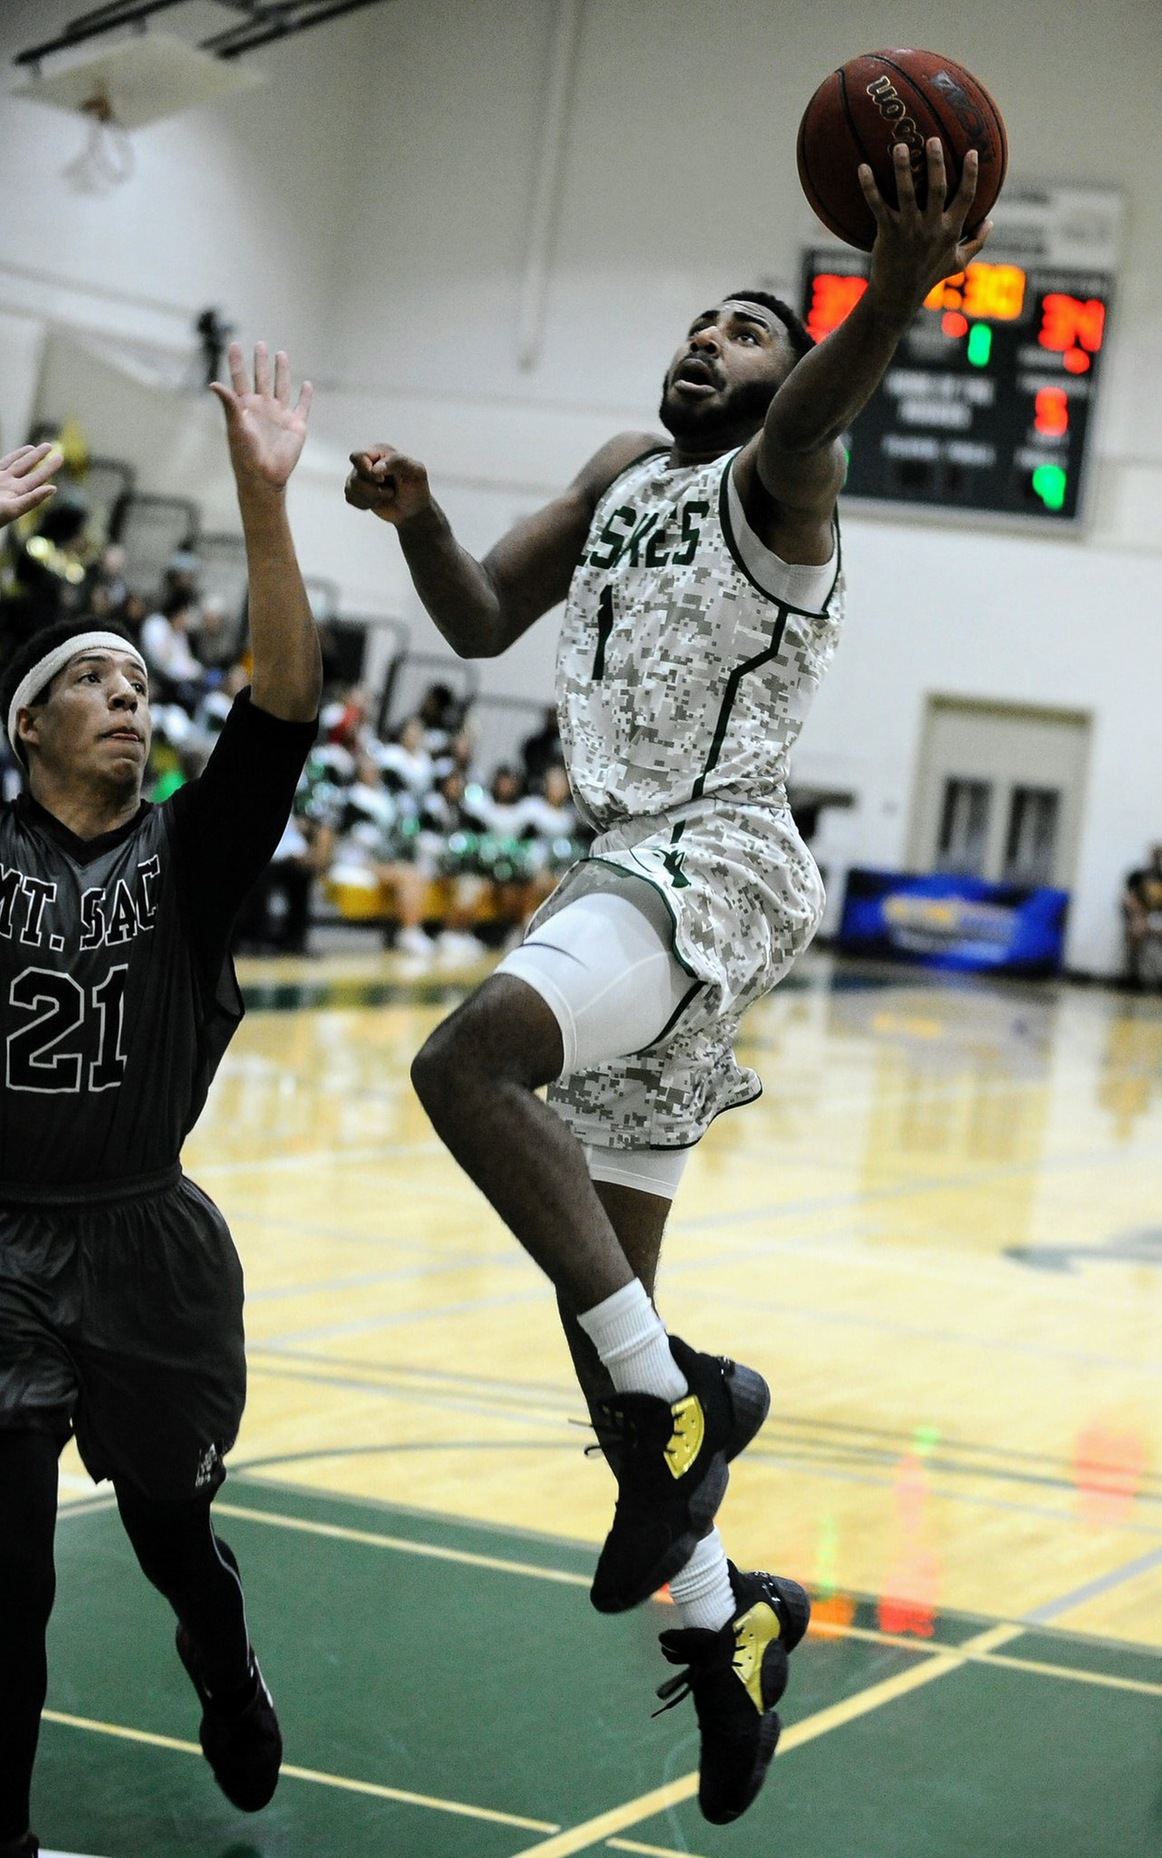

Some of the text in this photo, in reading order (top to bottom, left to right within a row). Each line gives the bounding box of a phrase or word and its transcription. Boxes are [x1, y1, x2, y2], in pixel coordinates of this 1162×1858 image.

[866, 74, 927, 180] lson
[591, 584, 614, 681] 1
[79, 853, 161, 950] SAC
[6, 963, 129, 1094] 21
